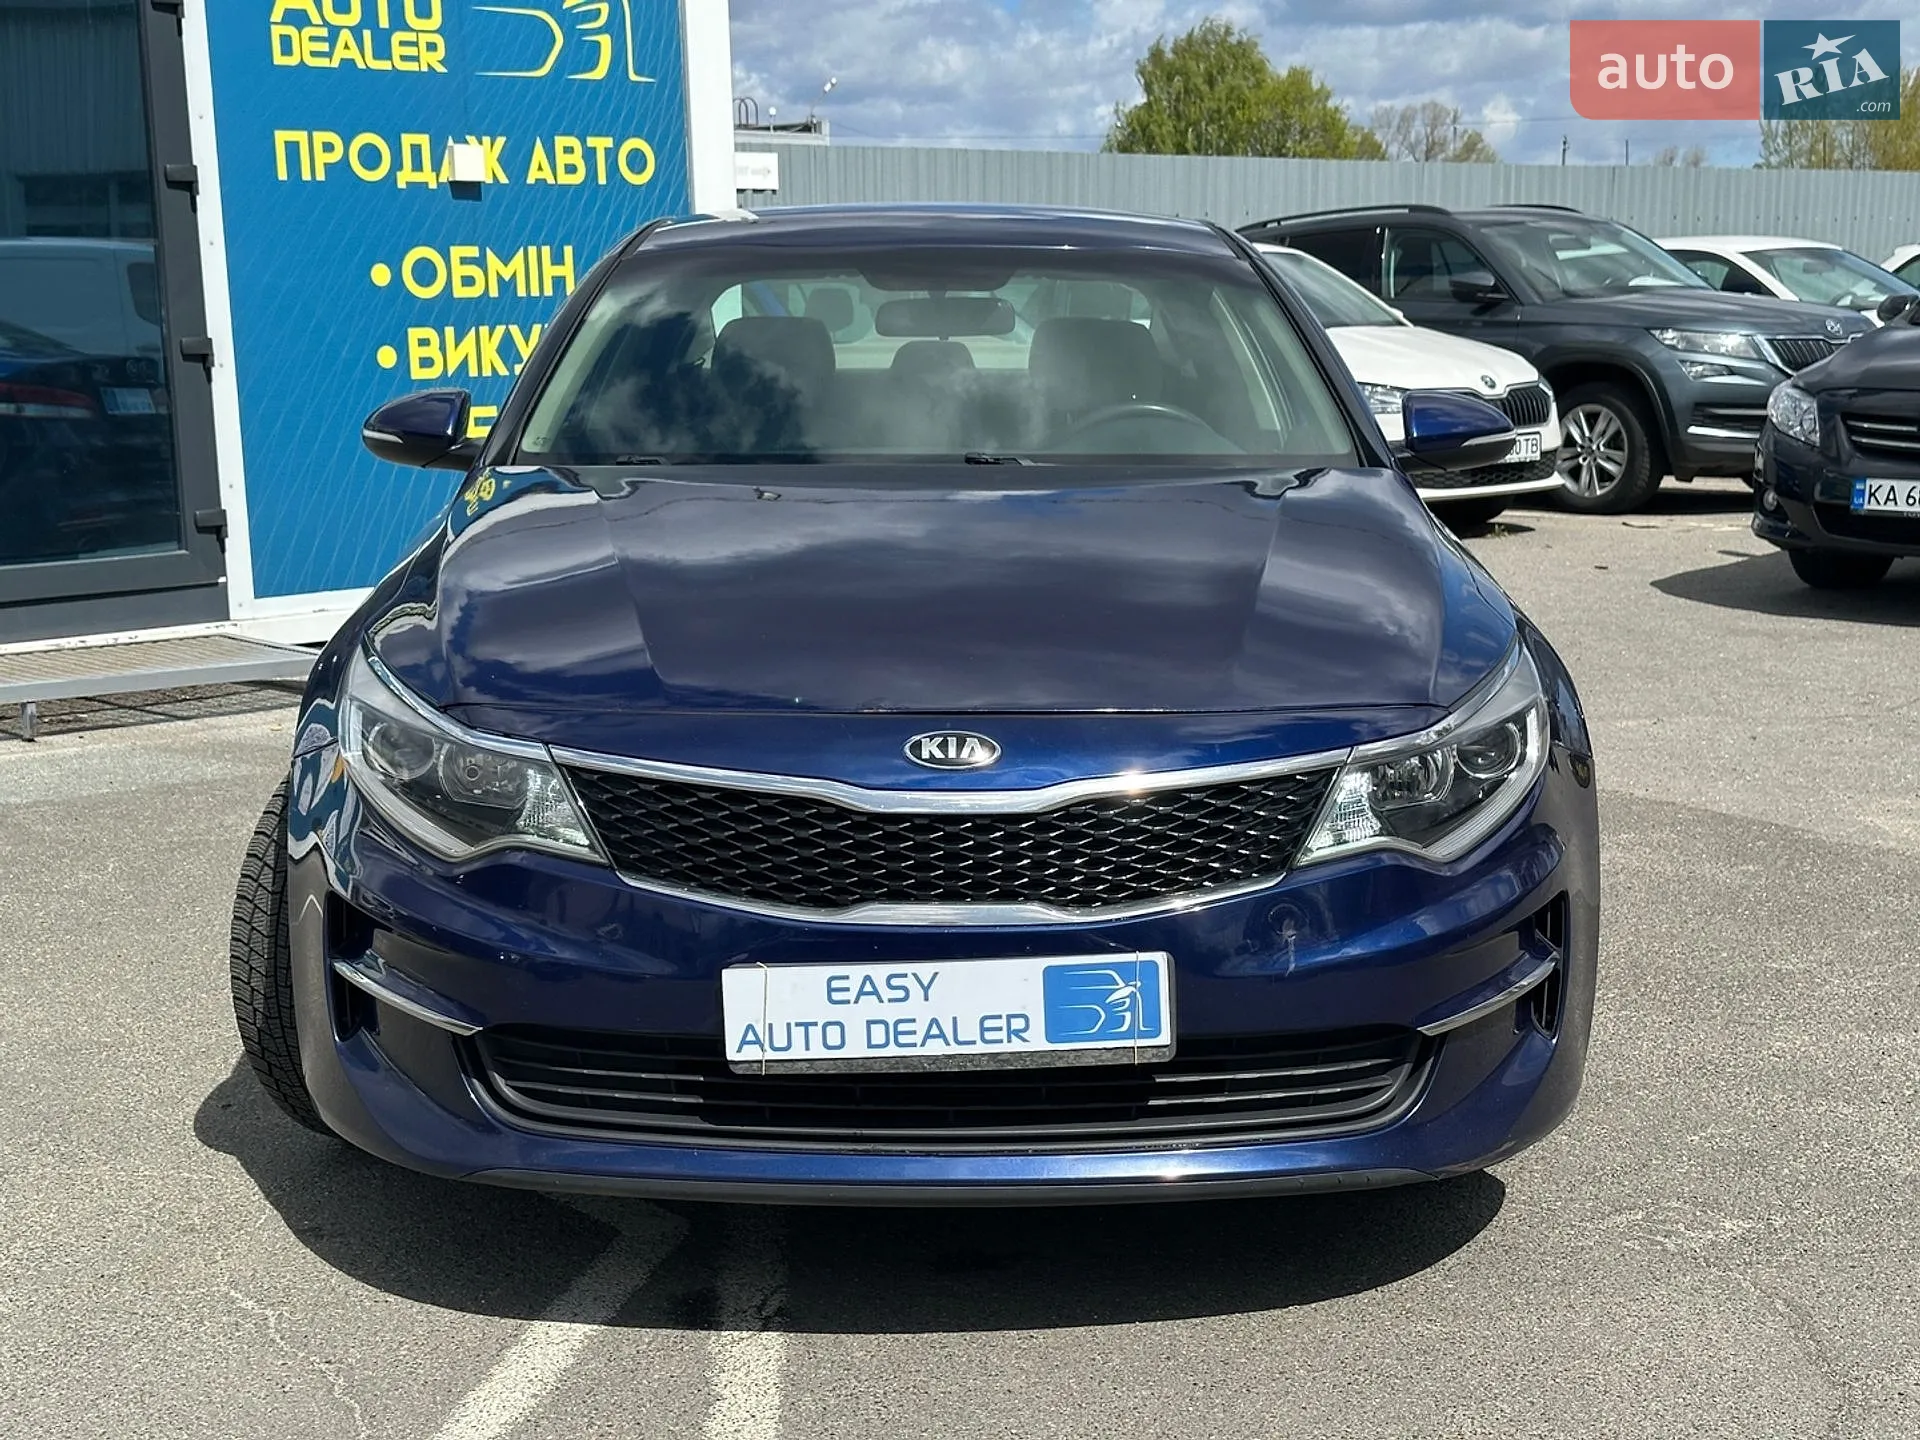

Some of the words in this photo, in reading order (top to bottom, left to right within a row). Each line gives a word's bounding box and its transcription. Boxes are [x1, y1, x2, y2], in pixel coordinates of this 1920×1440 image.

[270, 24, 449, 73] DEALER
[526, 135, 656, 186] АВТО
[401, 245, 576, 299] ОБМІН
[407, 323, 549, 380] ВИКУ
[1868, 484, 1898, 506] KA
[1906, 485, 1920, 507] 6
[921, 737, 982, 759] KIA
[826, 971, 940, 1005] EASY
[736, 1020, 847, 1054] AUTO
[866, 1013, 1031, 1050] DEALER
